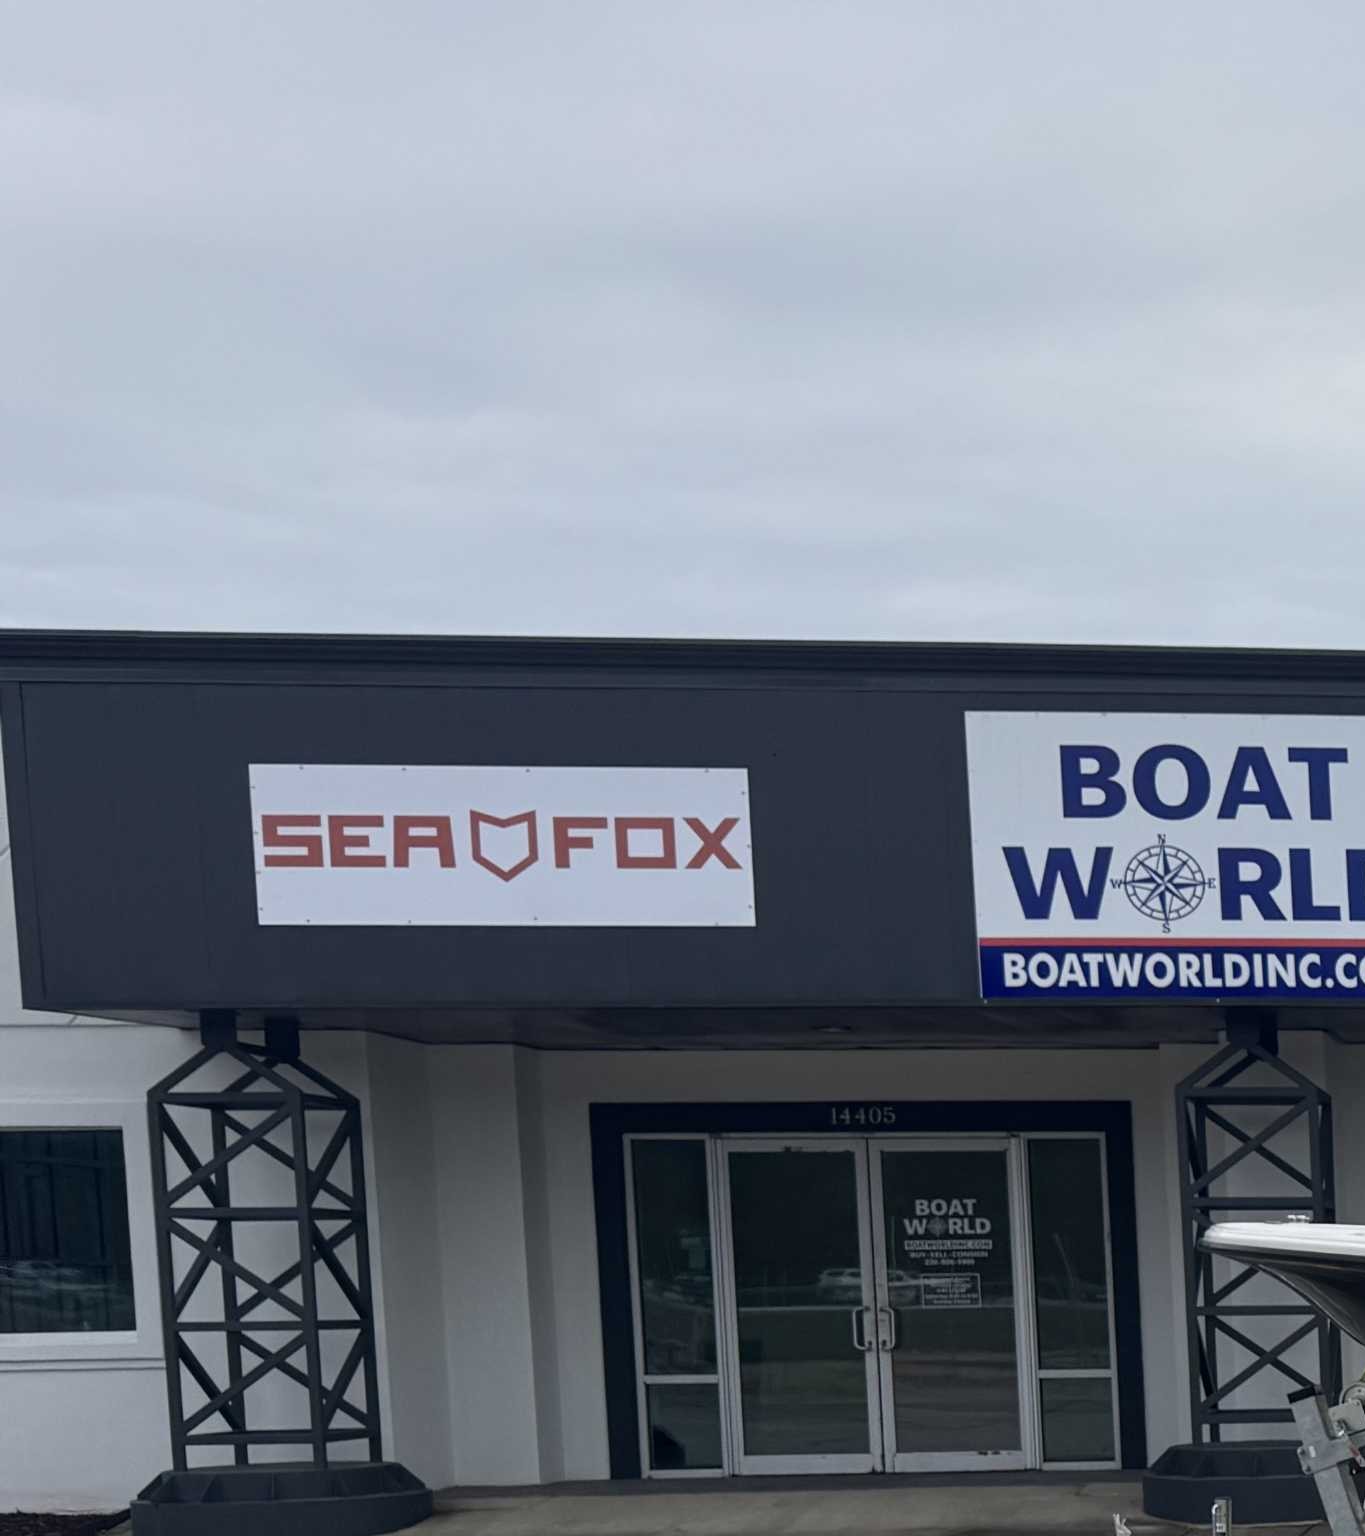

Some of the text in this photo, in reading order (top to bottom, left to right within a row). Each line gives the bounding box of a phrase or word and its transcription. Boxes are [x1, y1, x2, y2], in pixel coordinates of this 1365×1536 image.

[1059, 744, 1349, 821] BOAT
[261, 814, 743, 870] SEA FOX
[832, 1106, 896, 1125] 14405
[915, 1199, 977, 1217] BOAT
